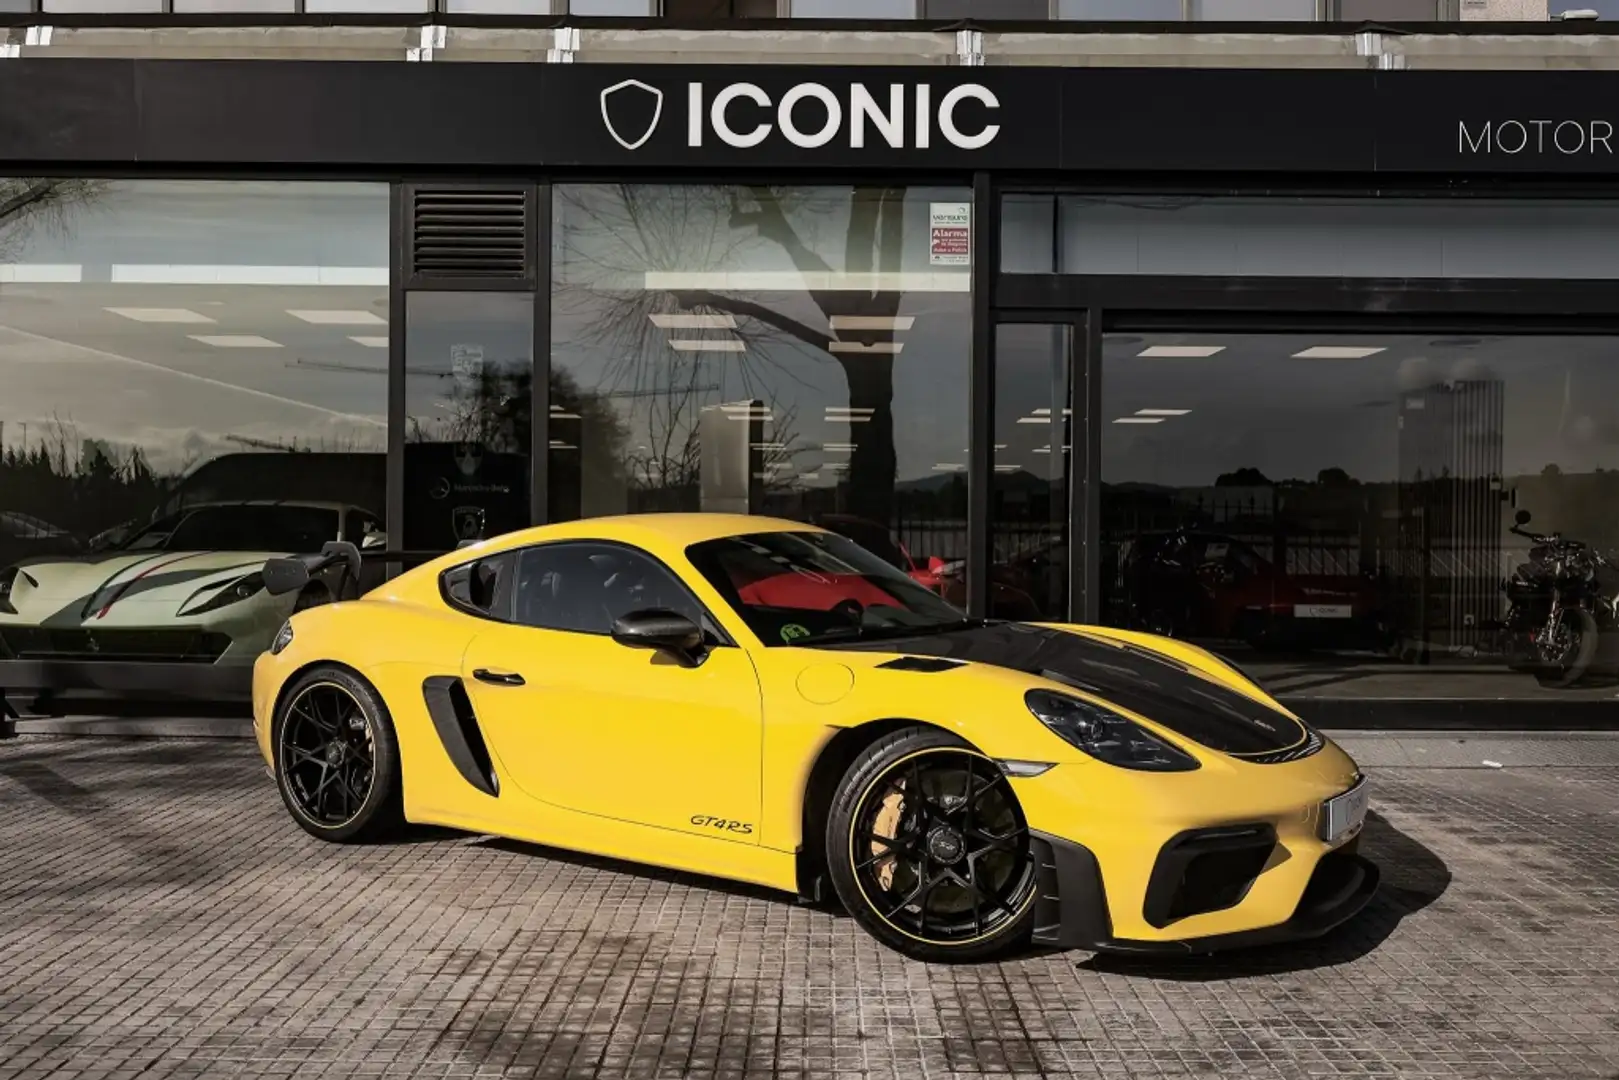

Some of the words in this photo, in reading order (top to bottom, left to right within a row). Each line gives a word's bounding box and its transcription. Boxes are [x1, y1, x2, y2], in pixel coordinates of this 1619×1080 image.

[687, 82, 1001, 149] ICONIC
[1458, 120, 1613, 154] MOTOR
[454, 483, 510, 493] Mercedes-Ben
[691, 815, 753, 834] GT4RS
